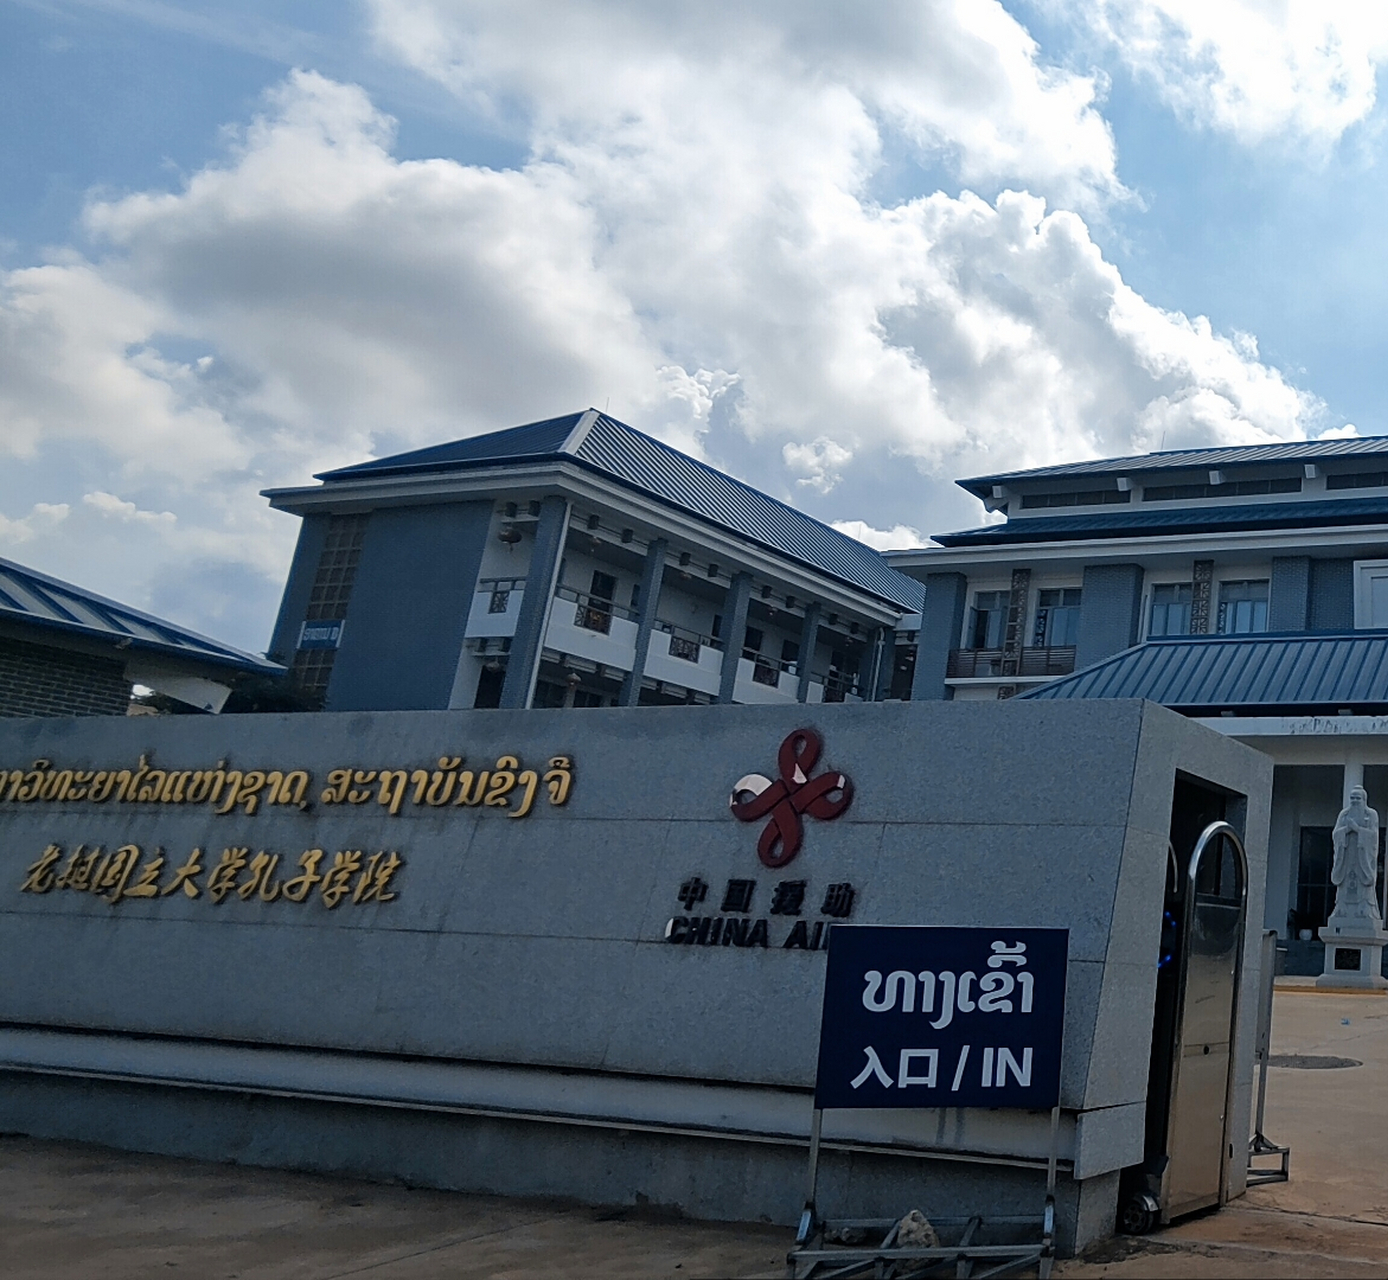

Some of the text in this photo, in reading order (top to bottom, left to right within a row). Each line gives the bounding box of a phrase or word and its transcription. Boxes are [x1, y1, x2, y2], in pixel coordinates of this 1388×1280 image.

[677, 876, 856, 918] 中国援助
[664, 916, 830, 950] CHINA AI
[862, 940, 1035, 1030] ທາງເຂົ້າ
[850, 1045, 939, 1090] 入口
[981, 1046, 1034, 1088] IN
